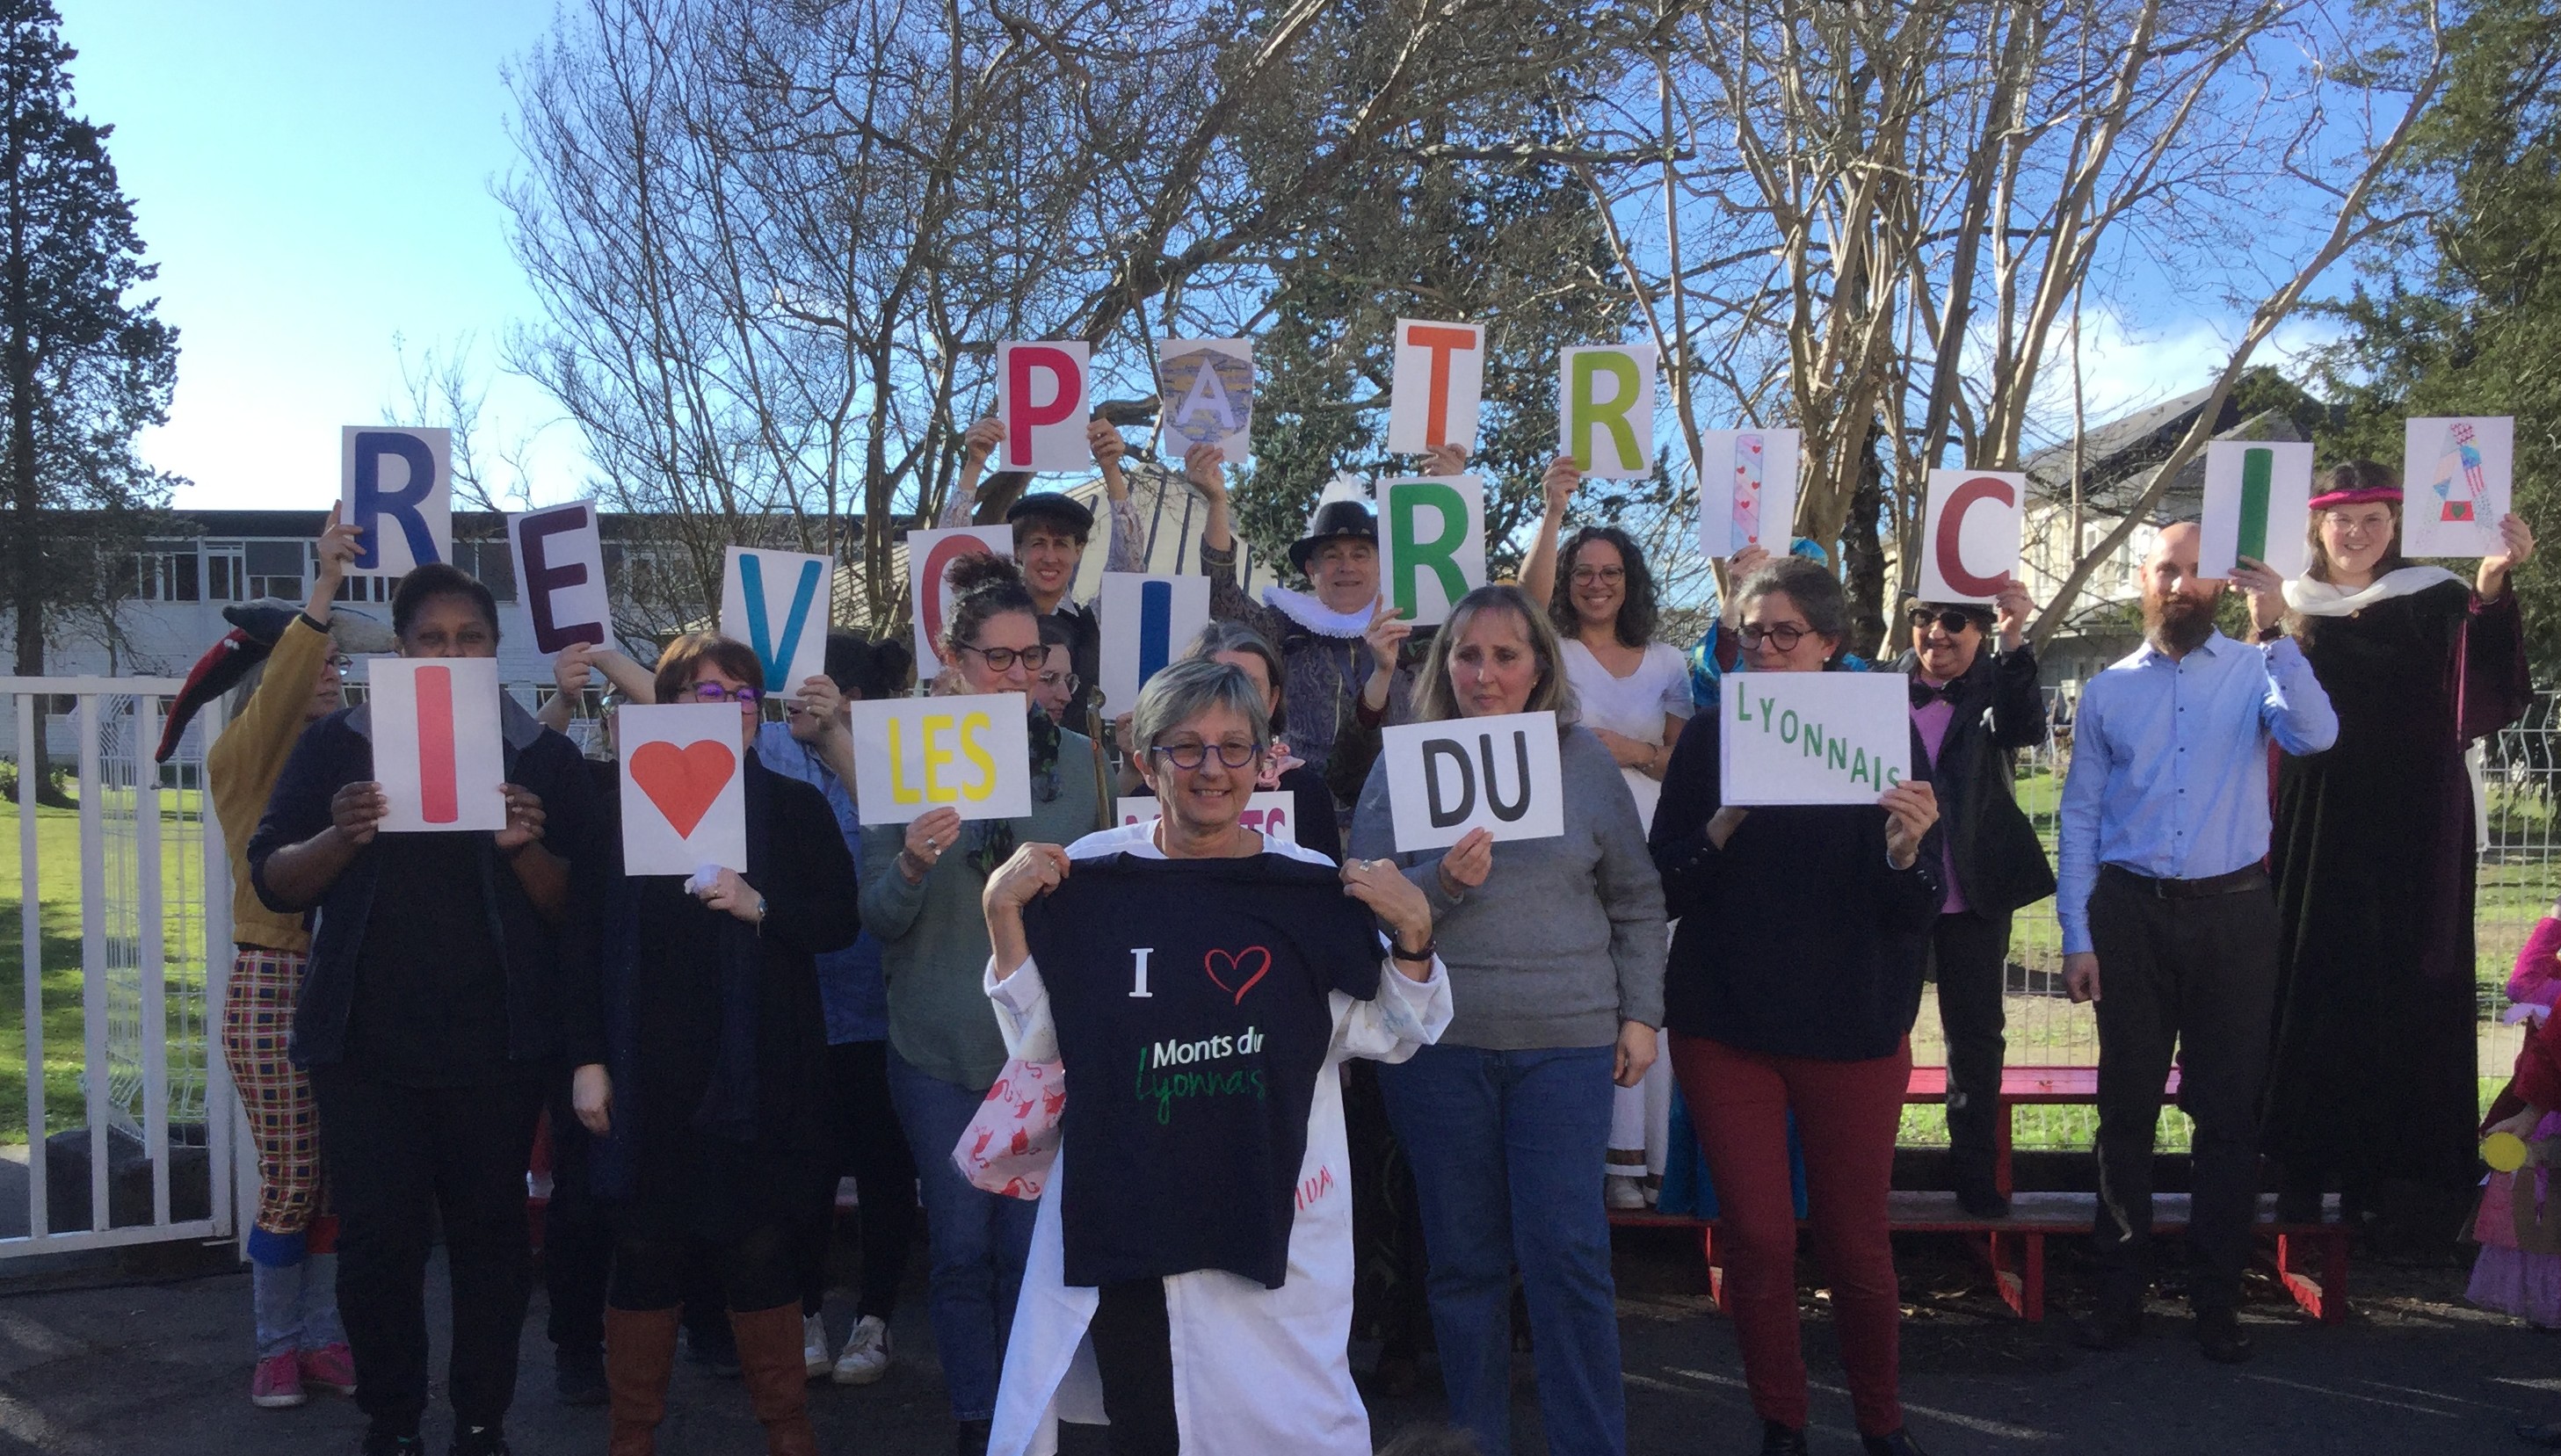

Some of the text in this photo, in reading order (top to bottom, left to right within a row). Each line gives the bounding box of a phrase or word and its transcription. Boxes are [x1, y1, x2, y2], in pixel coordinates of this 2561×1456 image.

[1009, 347, 1082, 466] P
[1177, 357, 1236, 428] A
[1407, 325, 1476, 448] T
[1571, 351, 1644, 471] R
[353, 431, 439, 569] R
[1936, 477, 2015, 597] C
[2235, 448, 2274, 570] I
[2413, 423, 2496, 549] A
[519, 505, 605, 654] E
[1389, 483, 1469, 620] R
[738, 554, 823, 692] V
[415, 665, 458, 823] I
[887, 711, 998, 805] LES
[1422, 730, 1531, 829] DU
[1738, 681, 1899, 792] LYONNAIS
[1128, 947, 1154, 997] I
[1152, 1035, 1232, 1068] Monts
